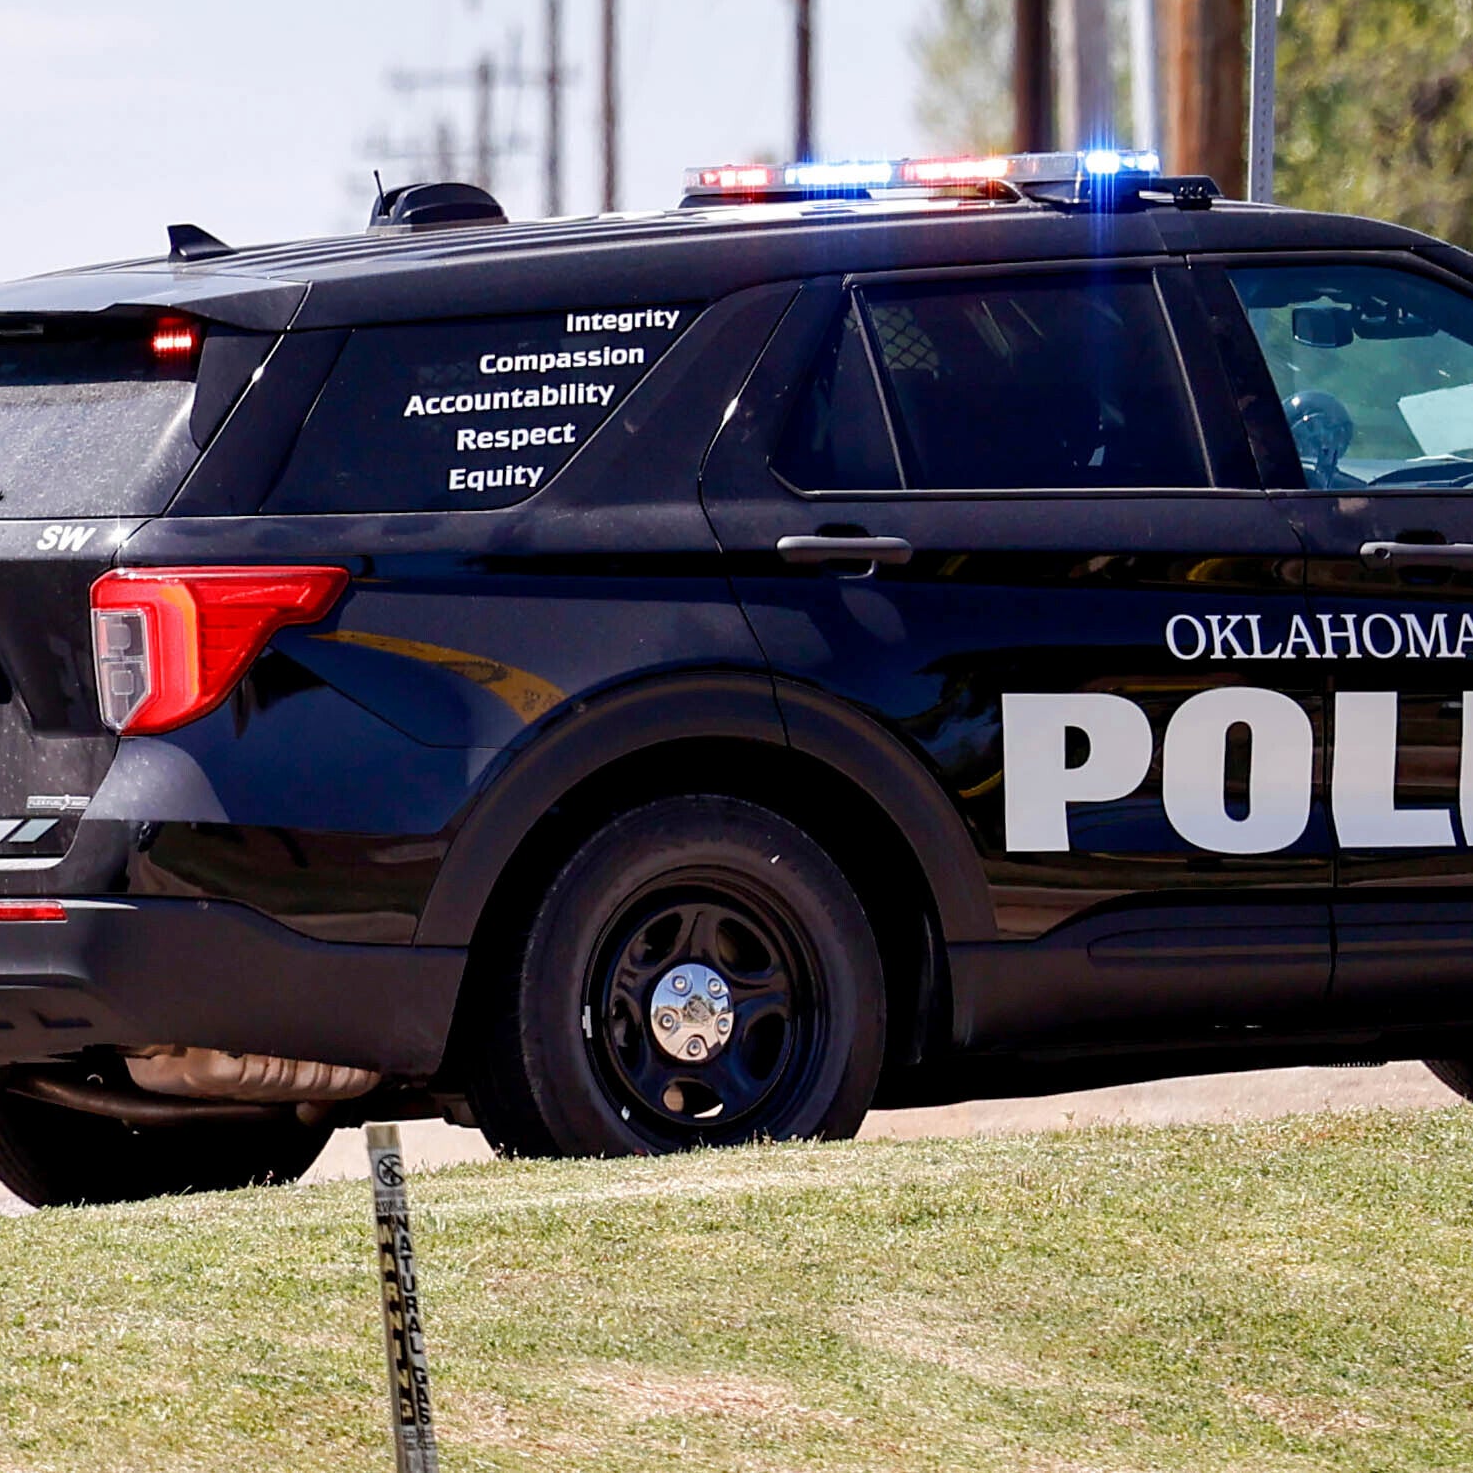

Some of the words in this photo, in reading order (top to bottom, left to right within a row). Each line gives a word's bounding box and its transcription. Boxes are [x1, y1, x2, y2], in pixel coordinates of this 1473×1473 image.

[566, 309, 680, 333] Integrity
[479, 346, 645, 375] Compassion
[403, 383, 615, 417] Accountability
[457, 422, 576, 451] Respect
[448, 465, 544, 492] Equity
[36, 525, 97, 552] SW
[378, 1223, 414, 1419] WARNING
[396, 1213, 423, 1355] NATURAL
[411, 1366, 431, 1425] GAS
